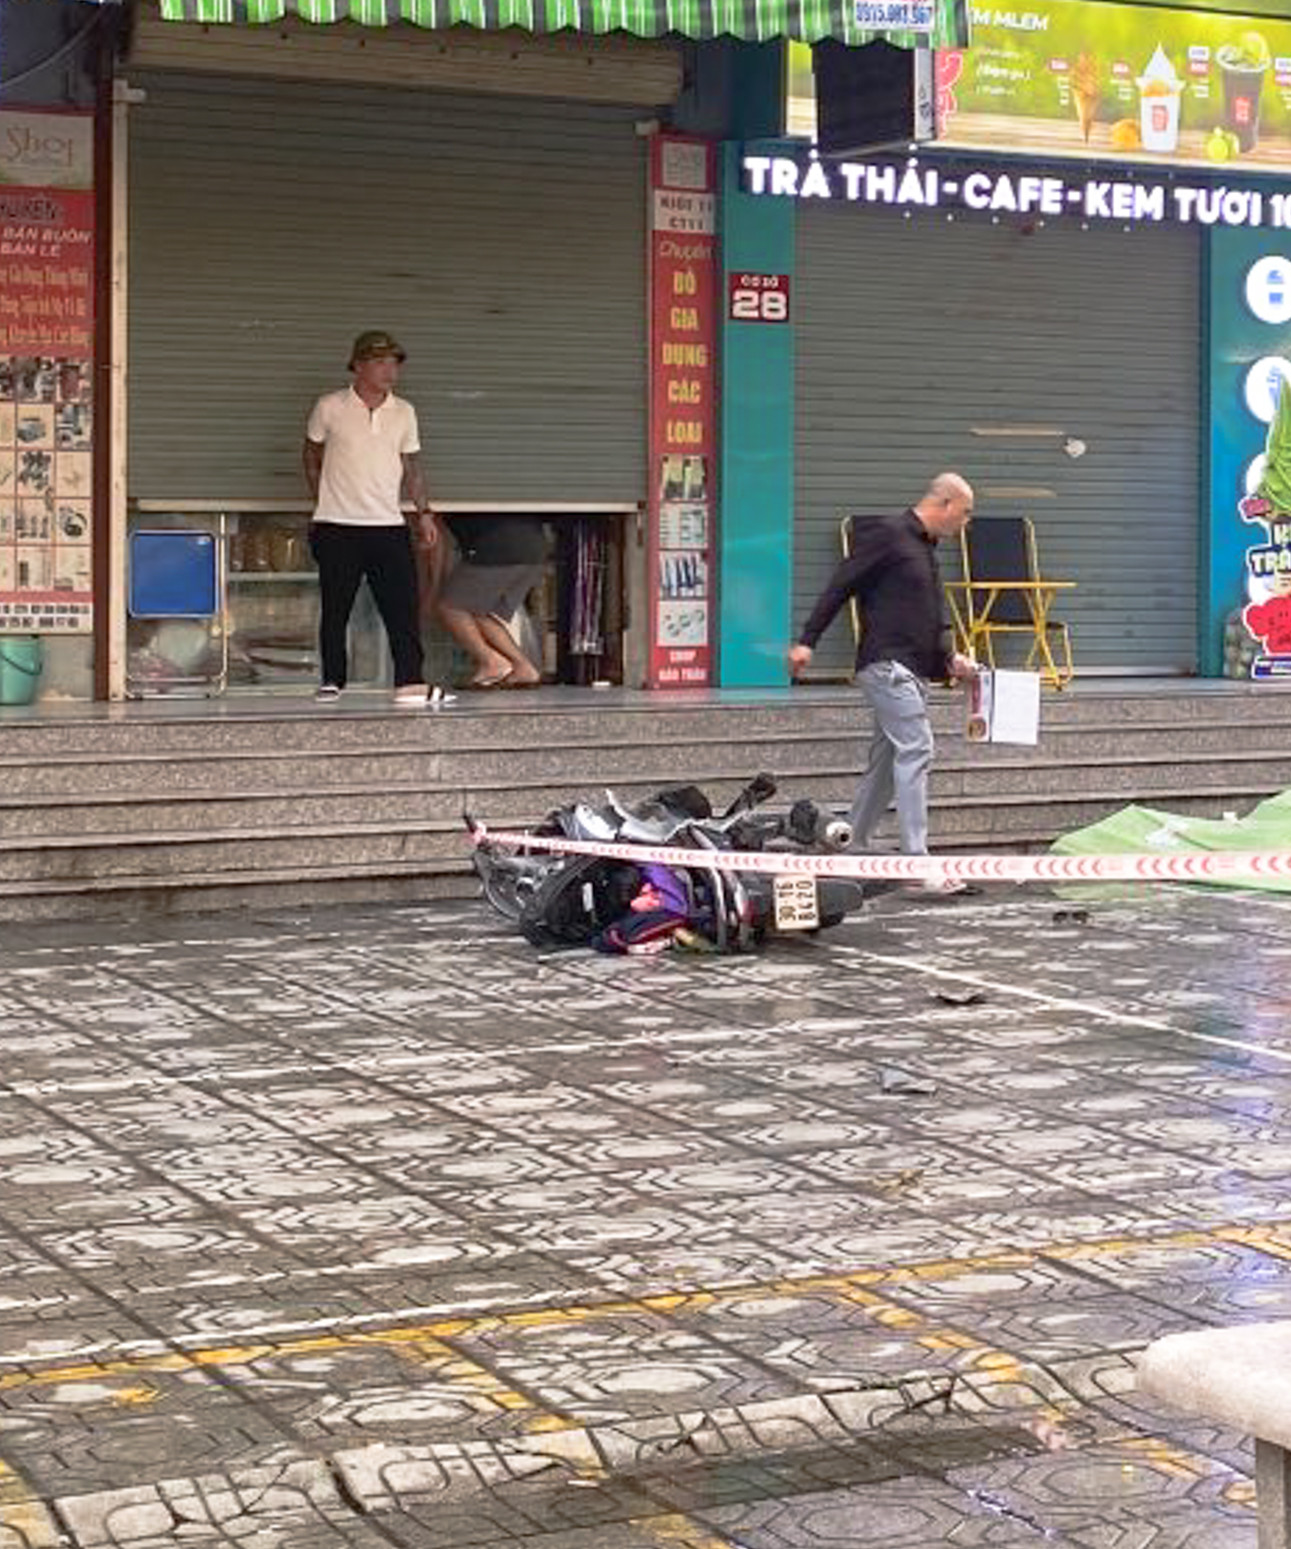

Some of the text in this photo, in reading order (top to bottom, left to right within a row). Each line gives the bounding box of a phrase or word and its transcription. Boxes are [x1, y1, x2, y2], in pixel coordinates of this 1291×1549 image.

[994, 12, 1048, 31] MLEM
[744, 149, 831, 198] TRÀ
[841, 158, 938, 206] THÁI
[1173, 185, 1262, 227] TƯƠI
[732, 290, 788, 320] 28
